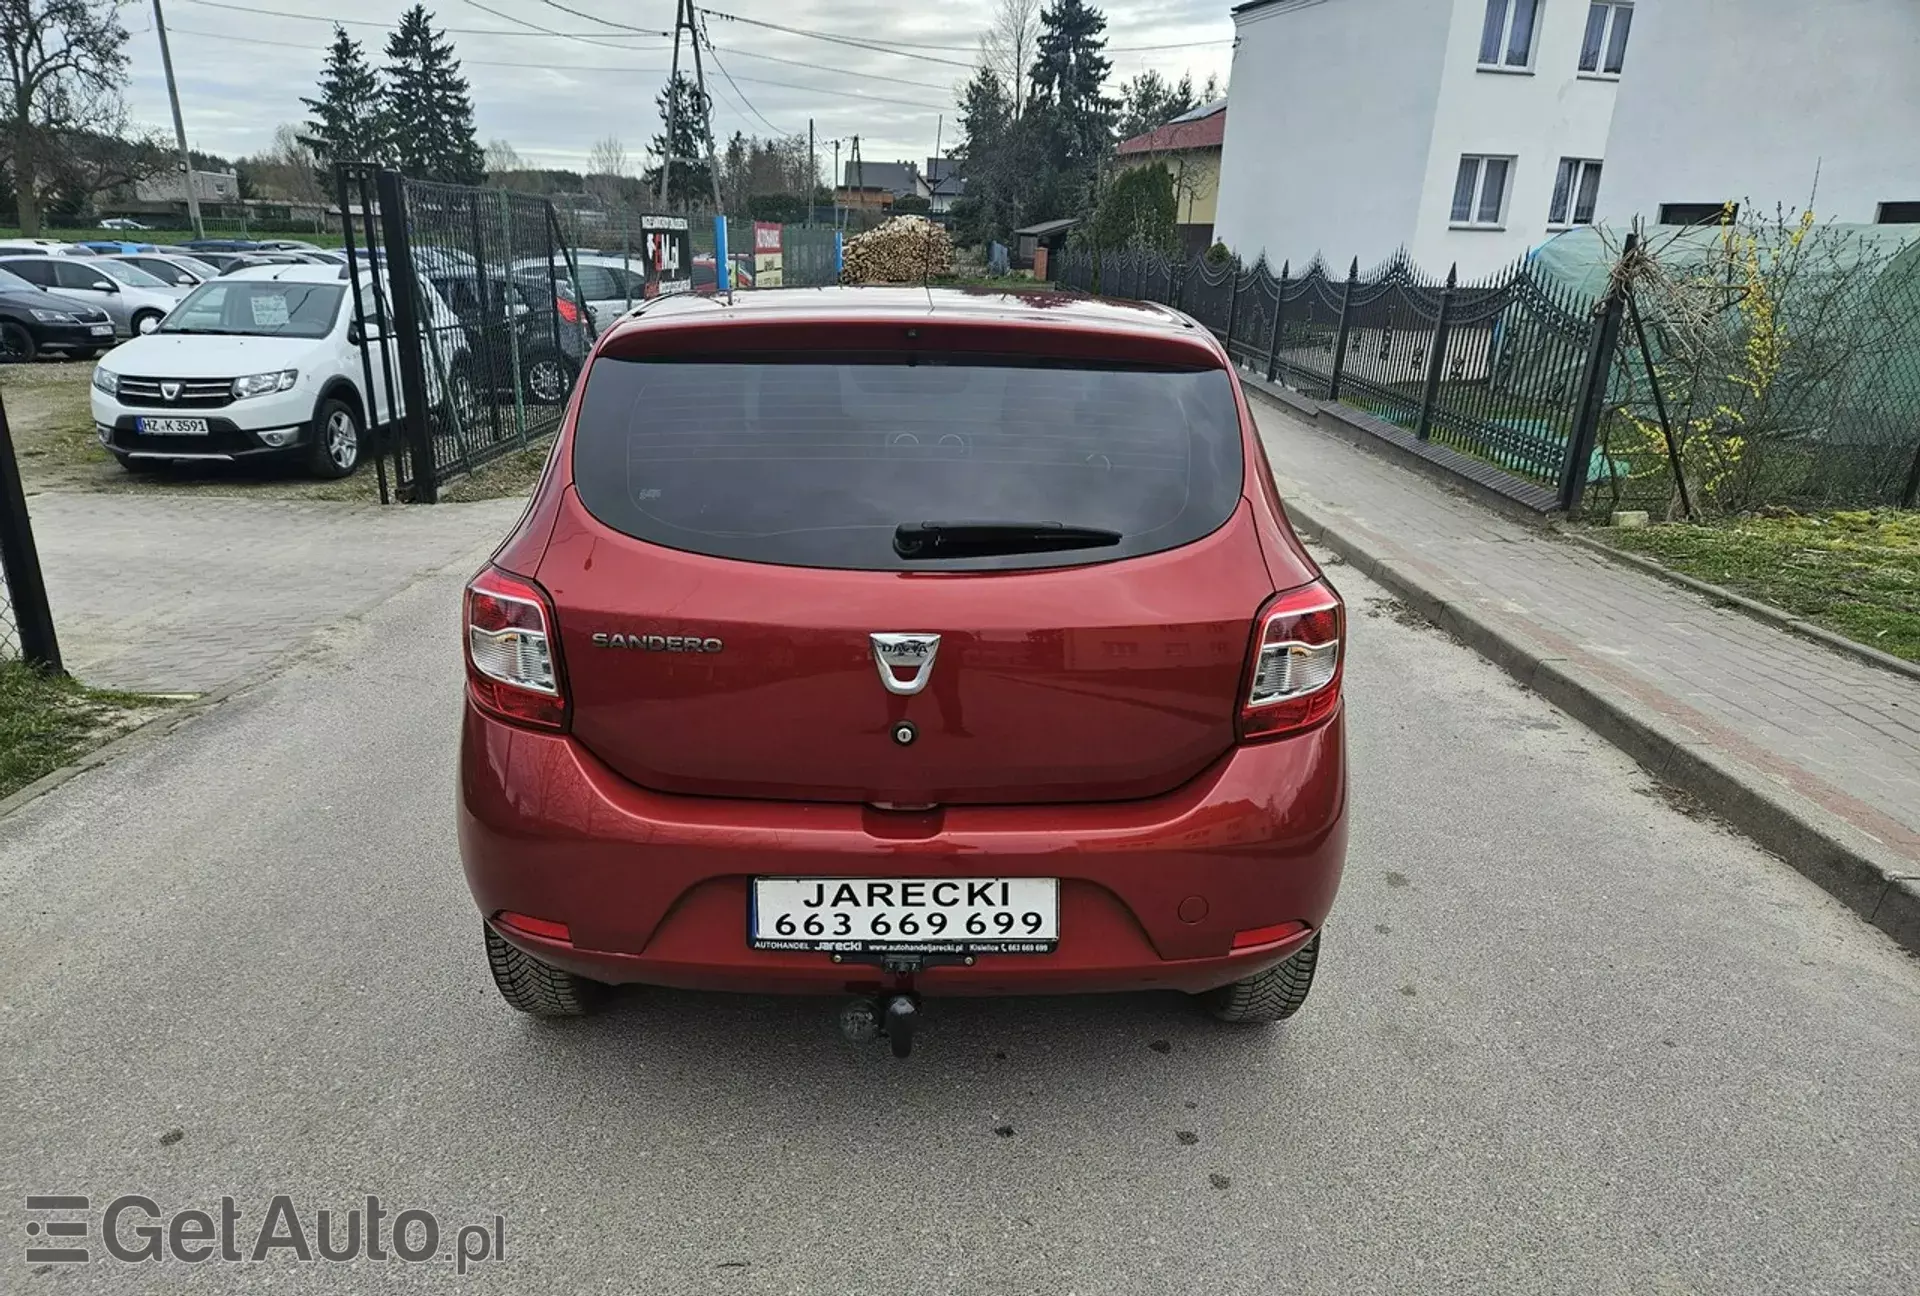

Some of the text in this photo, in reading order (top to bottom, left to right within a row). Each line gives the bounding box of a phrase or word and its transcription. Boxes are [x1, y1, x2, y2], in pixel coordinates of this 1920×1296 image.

[165, 420, 174, 431] K
[176, 420, 206, 431] 3591
[591, 632, 723, 654] SANDERO
[803, 882, 1009, 907] JARECKI
[774, 911, 1043, 936] 663 669 699
[754, 940, 1048, 953] AUTOHANDEL Jarecki www.autohandeljarecki.pl Kisielice 663 669 699
